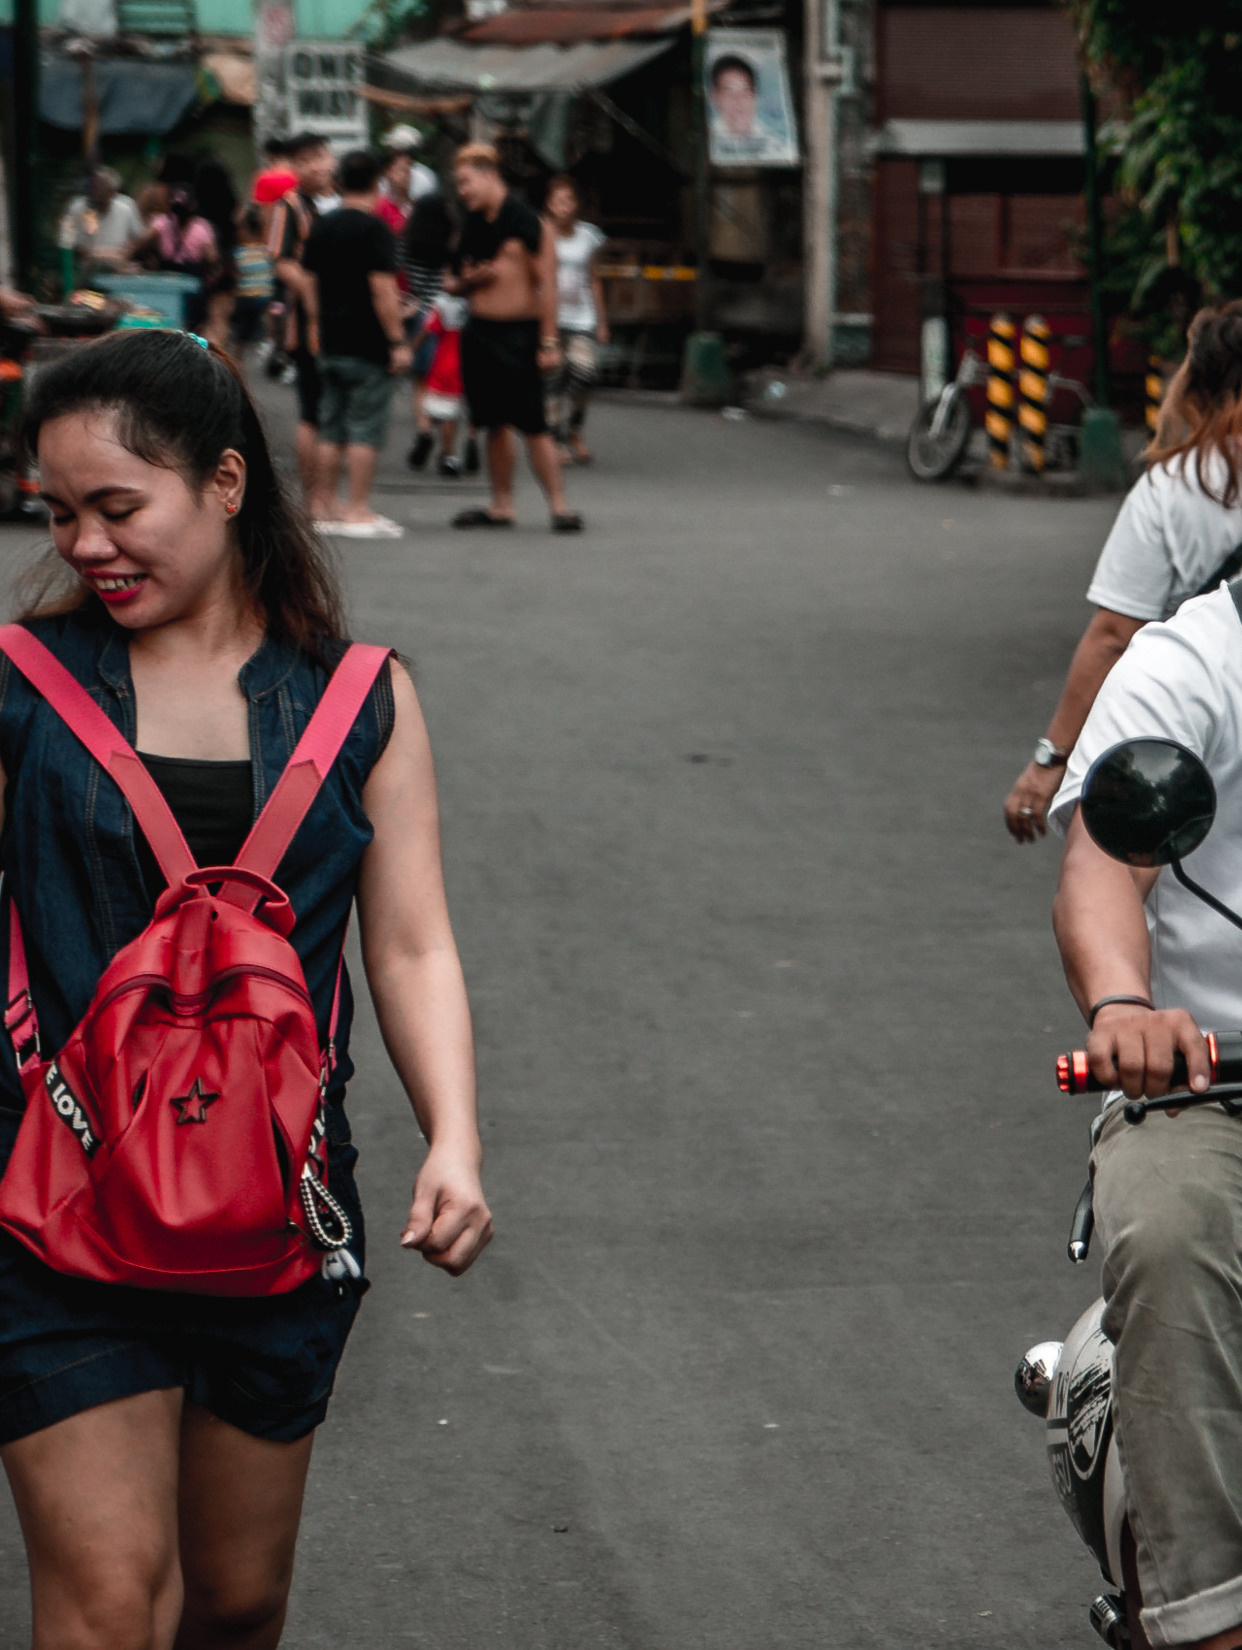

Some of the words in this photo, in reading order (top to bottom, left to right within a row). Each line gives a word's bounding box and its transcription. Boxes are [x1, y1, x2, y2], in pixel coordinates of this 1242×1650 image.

[294, 50, 357, 80] ONE
[298, 89, 357, 116] WAY
[52, 1082, 95, 1151] LOVE
